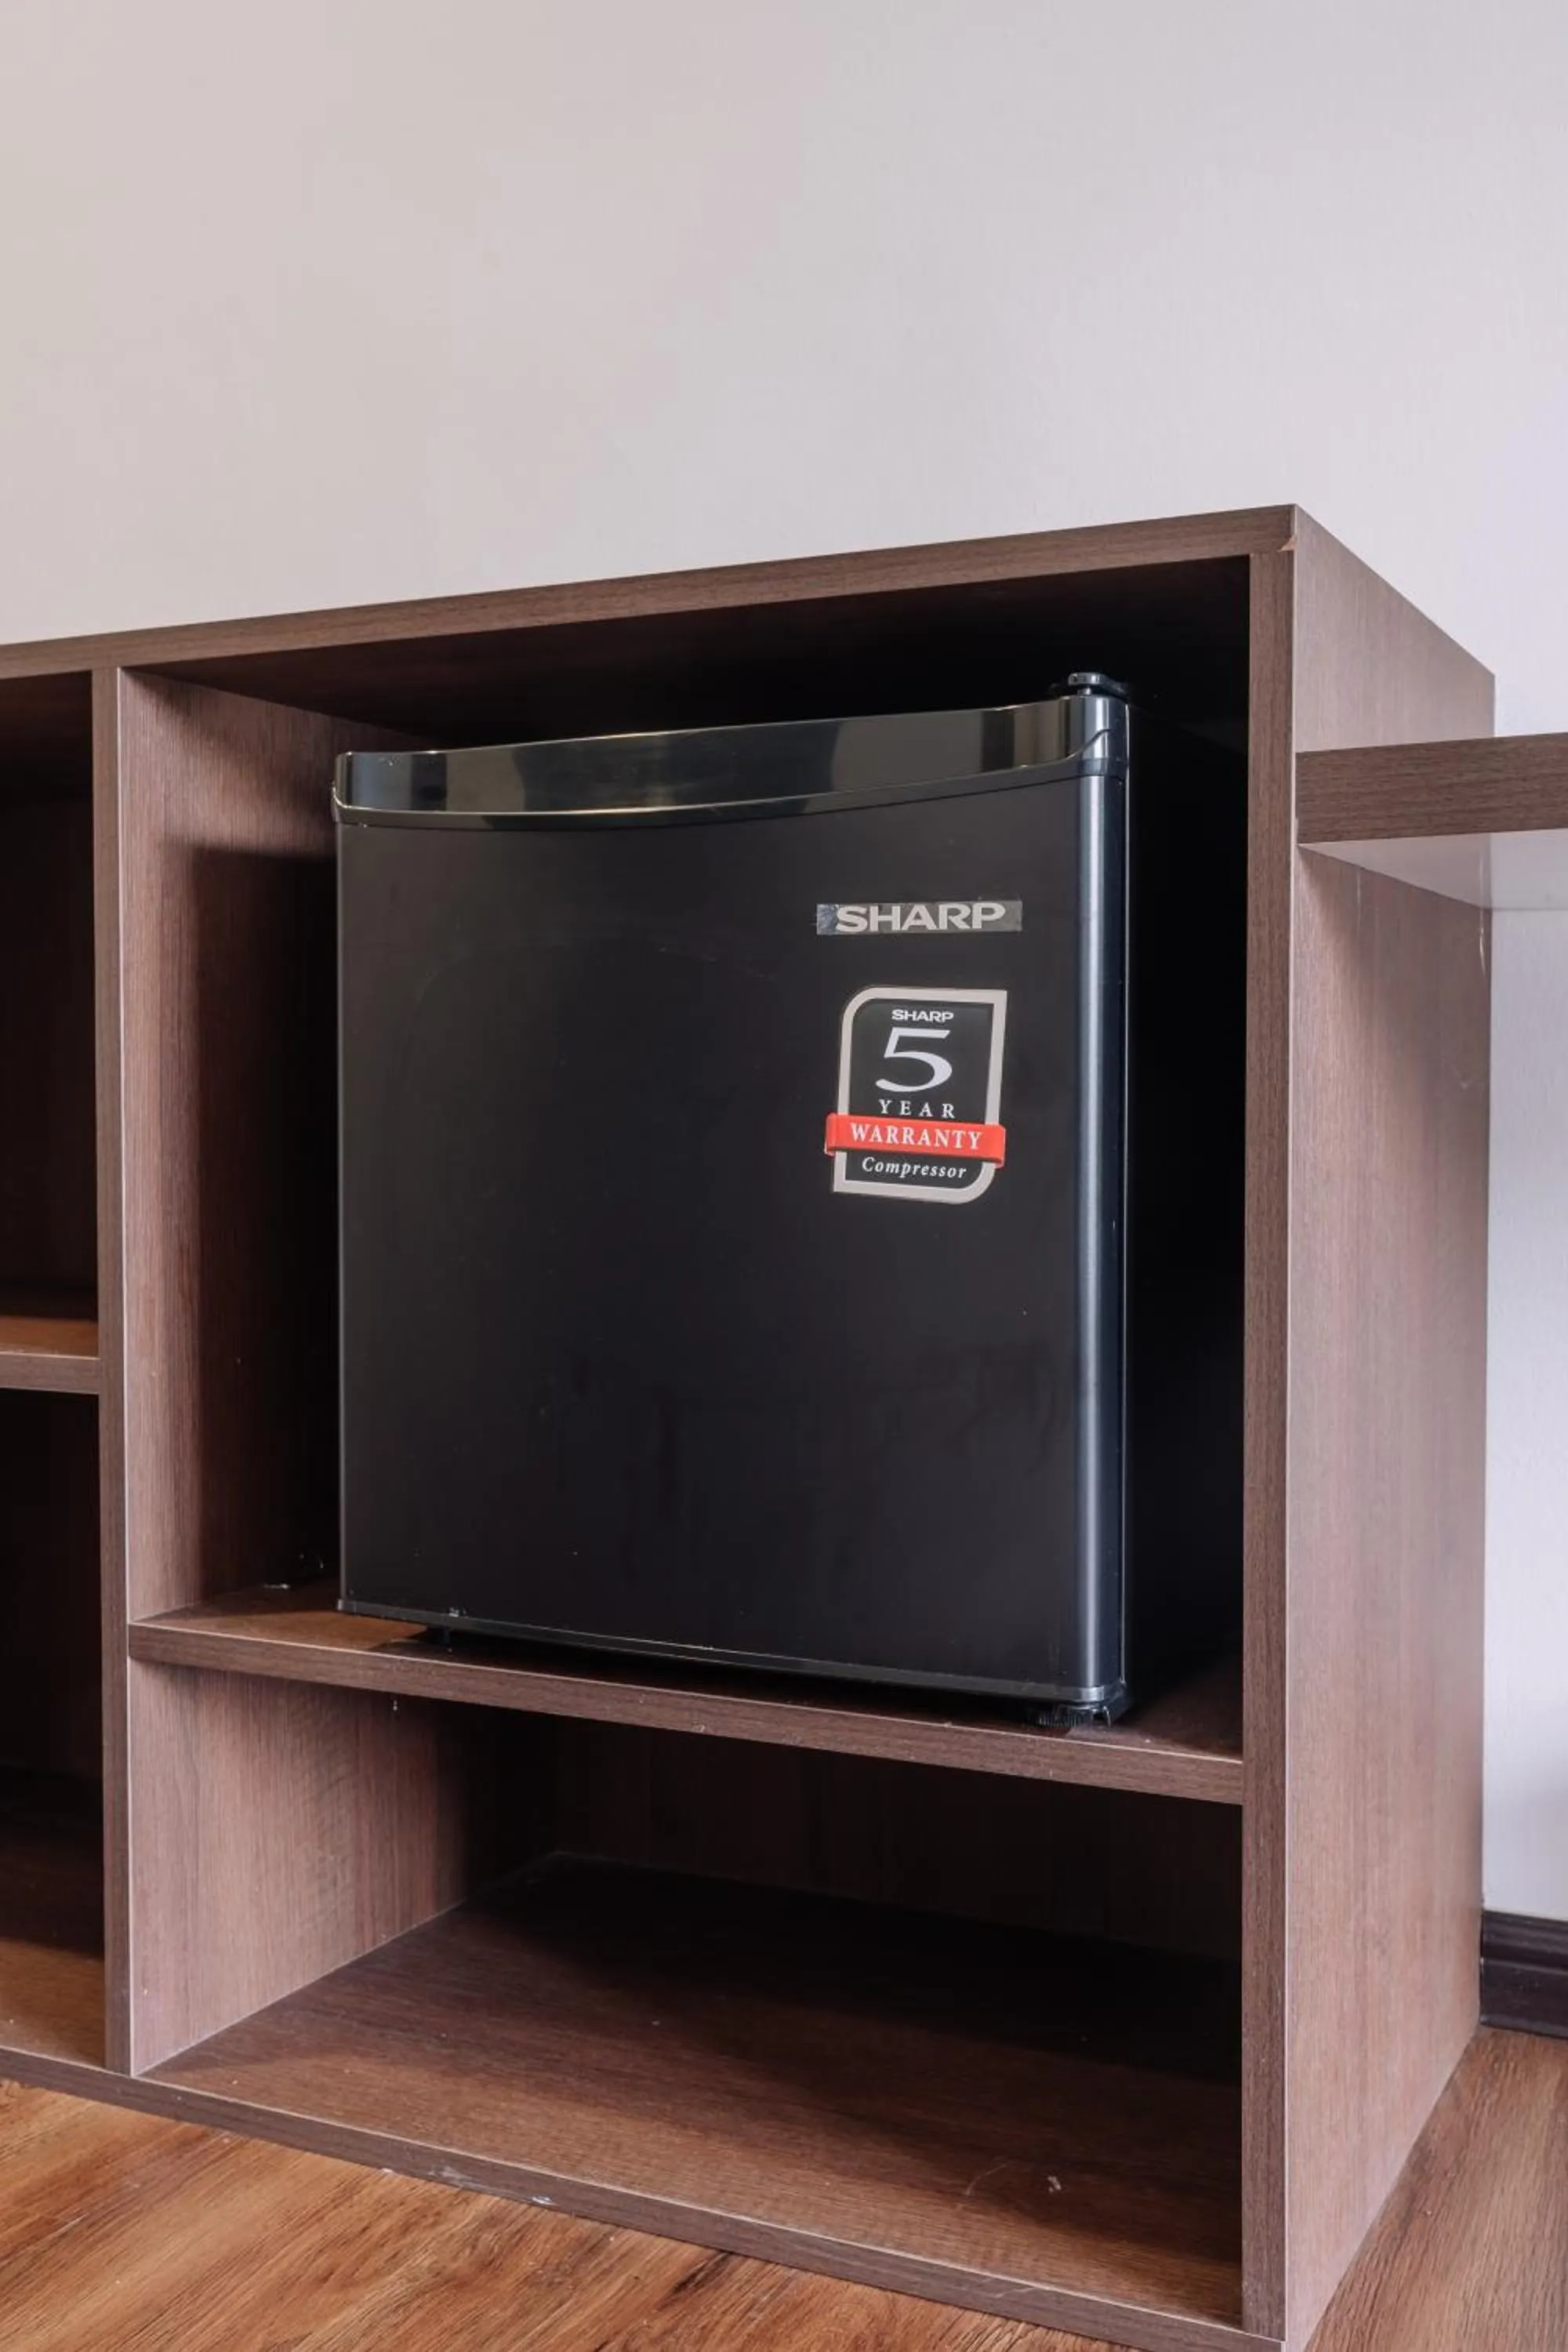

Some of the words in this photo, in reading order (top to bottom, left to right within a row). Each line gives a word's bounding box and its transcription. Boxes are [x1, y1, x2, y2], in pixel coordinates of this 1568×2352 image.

[836, 903, 1005, 932] SHARP
[891, 1009, 954, 1022] SHARP
[875, 1027, 953, 1092] 5
[879, 1099, 955, 1119] YEAR
[851, 1121, 982, 1150] WARRANTY
[862, 1156, 967, 1179] Compressor
